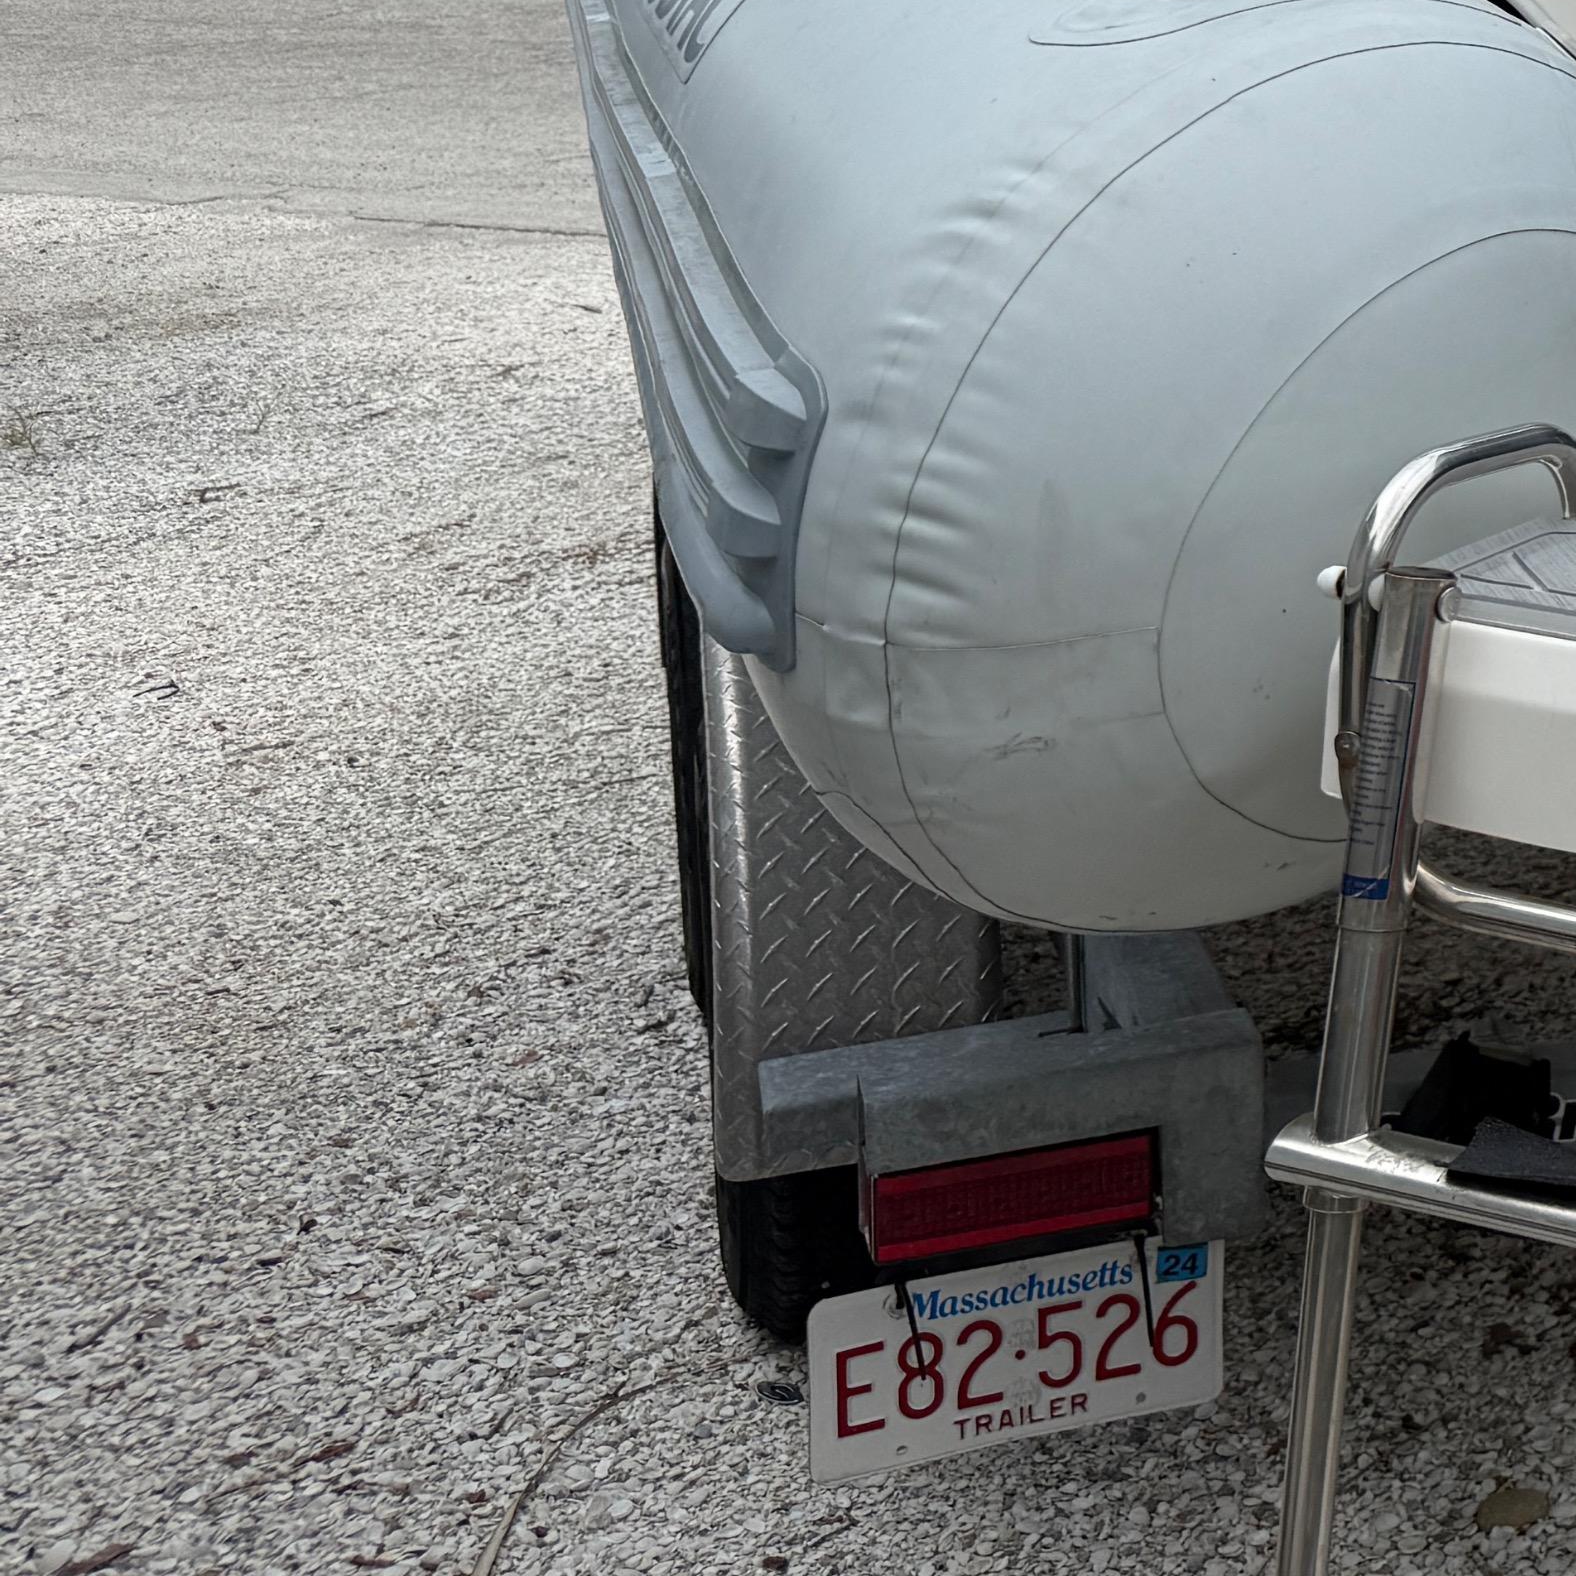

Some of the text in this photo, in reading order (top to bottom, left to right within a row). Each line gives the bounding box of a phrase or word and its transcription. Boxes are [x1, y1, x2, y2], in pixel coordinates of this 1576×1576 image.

[912, 1252, 1200, 1321] Massachusetts 24
[953, 1392, 1089, 1441] TRAILER
